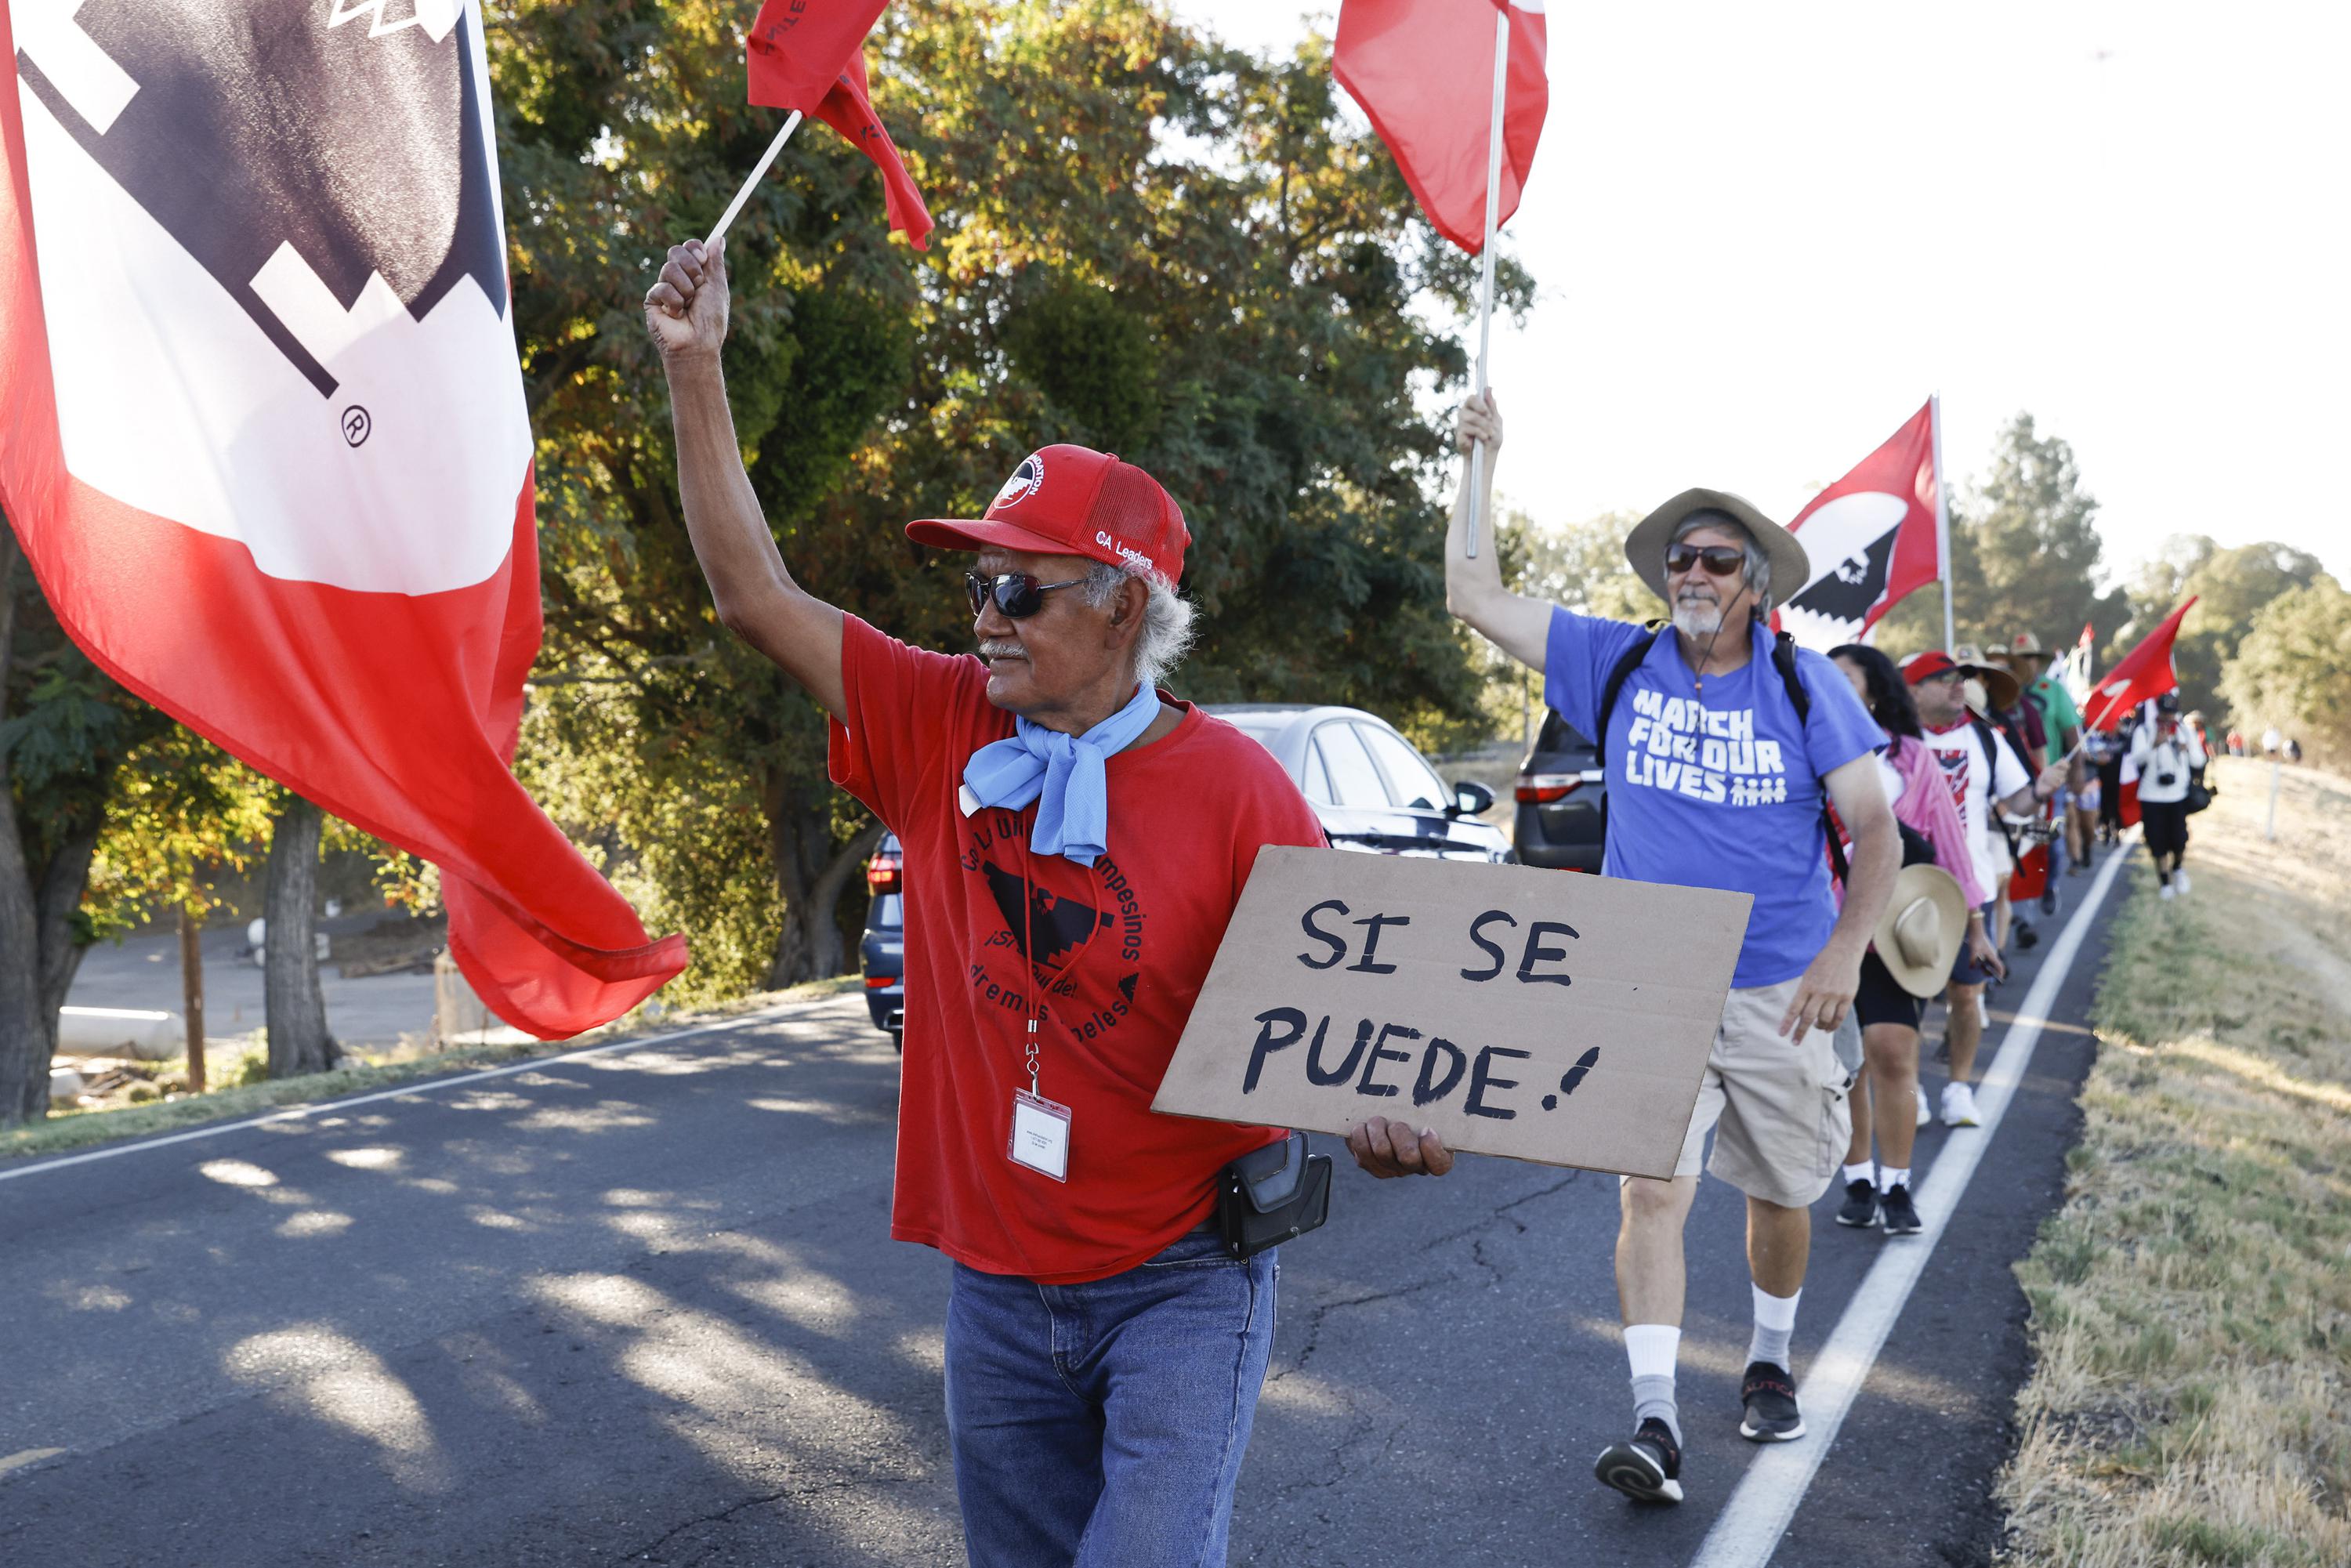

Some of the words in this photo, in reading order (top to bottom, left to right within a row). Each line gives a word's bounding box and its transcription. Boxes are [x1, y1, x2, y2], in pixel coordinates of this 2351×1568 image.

[1030, 454, 1045, 495] NDATION
[1096, 531, 1111, 550] CA
[1115, 540, 1153, 570] Leaders
[1632, 688, 1754, 741] MARCH
[1628, 716, 1697, 763] FOR
[1701, 738, 1785, 774] OUR
[1625, 750, 1726, 803] LIVES
[1296, 900, 1410, 974] SI
[1461, 910, 1580, 986] SE
[1243, 1007, 1600, 1120] PUEDE!
